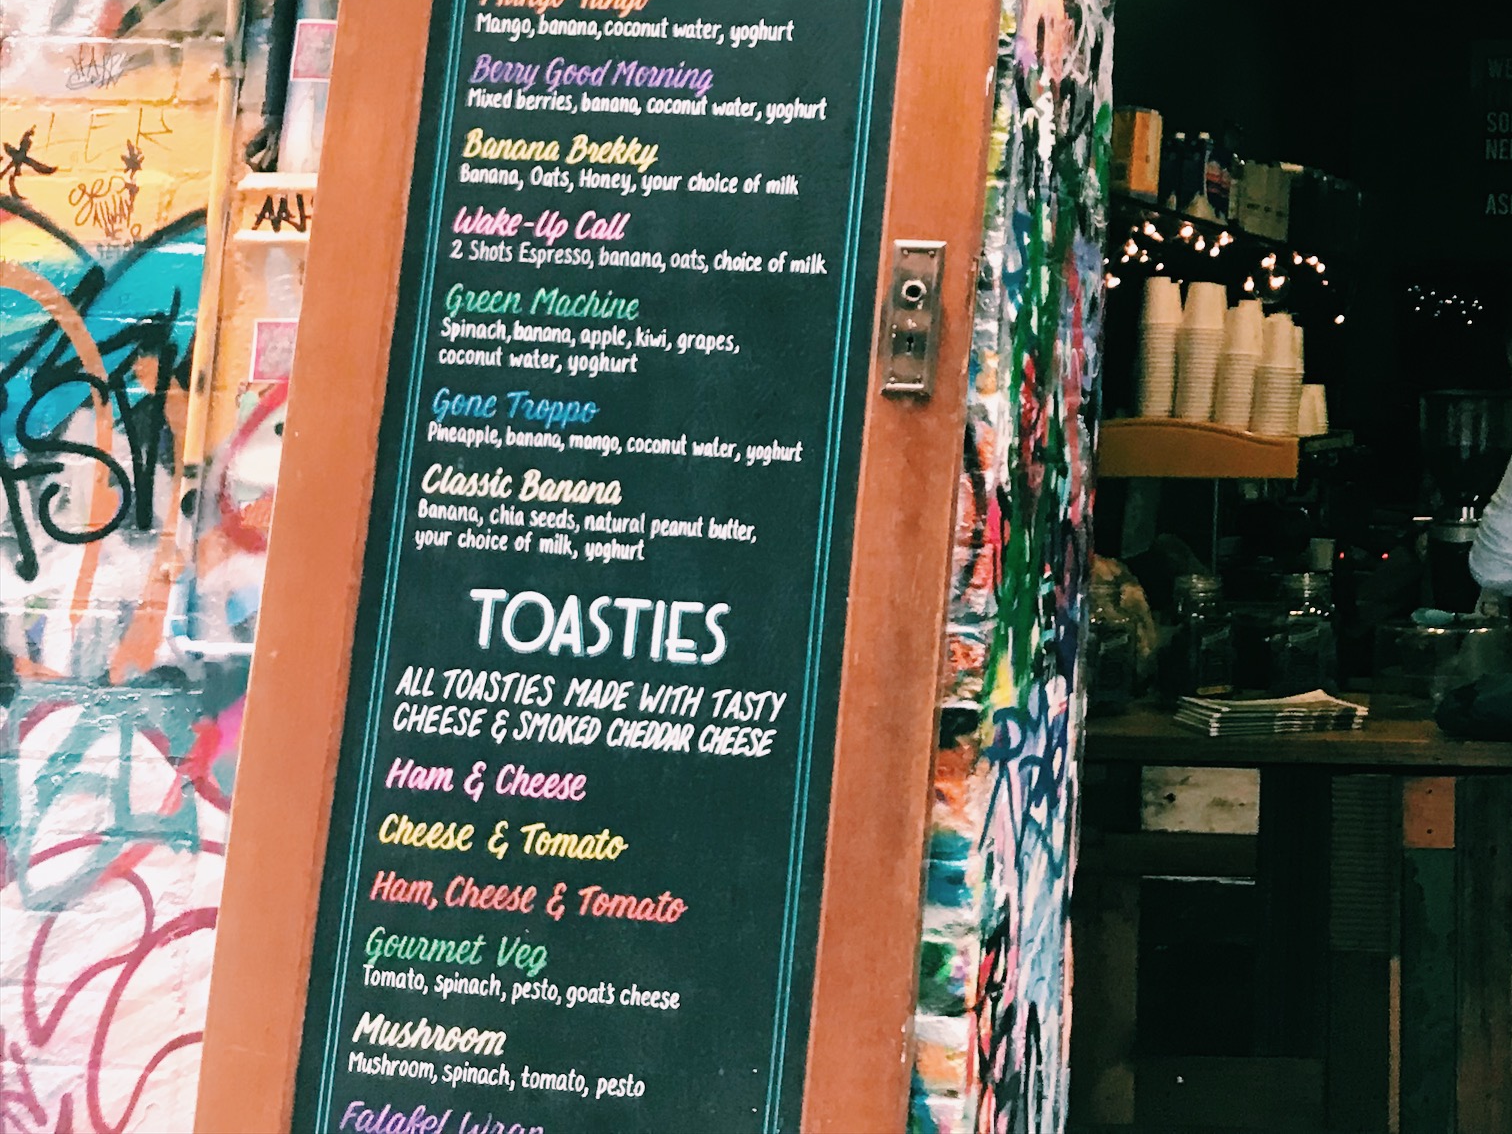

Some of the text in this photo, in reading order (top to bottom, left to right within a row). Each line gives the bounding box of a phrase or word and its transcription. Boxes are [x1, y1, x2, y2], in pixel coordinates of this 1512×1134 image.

[474, 12, 795, 49] Mango, banana, coconut water, yoghurt
[469, 53, 714, 99] Berry Good Morning
[466, 87, 828, 125] Mixed berries, banana, coconut water, yoghurt
[460, 127, 659, 174] Banana Brekky
[459, 162, 799, 197] Banana, Oats, Honey, your choice of milk
[452, 205, 632, 247] Wake-Up Call
[448, 238, 828, 275] 2 Shots Espresso, banana, oats, choice of milk
[446, 283, 639, 321] Green Machine
[440, 318, 740, 356] Spinach, banana, apple, kiwi, grapes,
[438, 345, 639, 378] coconut water, yoghurt
[431, 387, 600, 430] Gone Troppo
[427, 420, 804, 467] Pineapple, banana, mango, coconut water, yoghurt
[421, 463, 623, 506] Classic Banana
[417, 497, 757, 544] Banana, chia seeds, natural peanut butter,
[414, 527, 645, 564] your choice of milk, yoghurt
[469, 588, 732, 666] TOASTIES
[394, 665, 788, 723] ALL TOASTIES MADE WITH TASTY
[392, 701, 778, 758] CHEESE & SMOKED CHEDDAR CHEESE
[384, 756, 587, 803] Ham & Cheese
[378, 813, 629, 861] Cheese & Tomato
[369, 870, 689, 923] Ham, Cheese & Tomato
[364, 926, 548, 978] Gourmet Veg
[362, 964, 427, 995] Tomato,
[433, 972, 507, 1003] spinach,
[510, 977, 562, 1006] pesto,
[619, 983, 681, 1011] cheese
[351, 1011, 507, 1057] Mushroom
[347, 1051, 646, 1100] Mushroom, spinach, tomato, pesto
